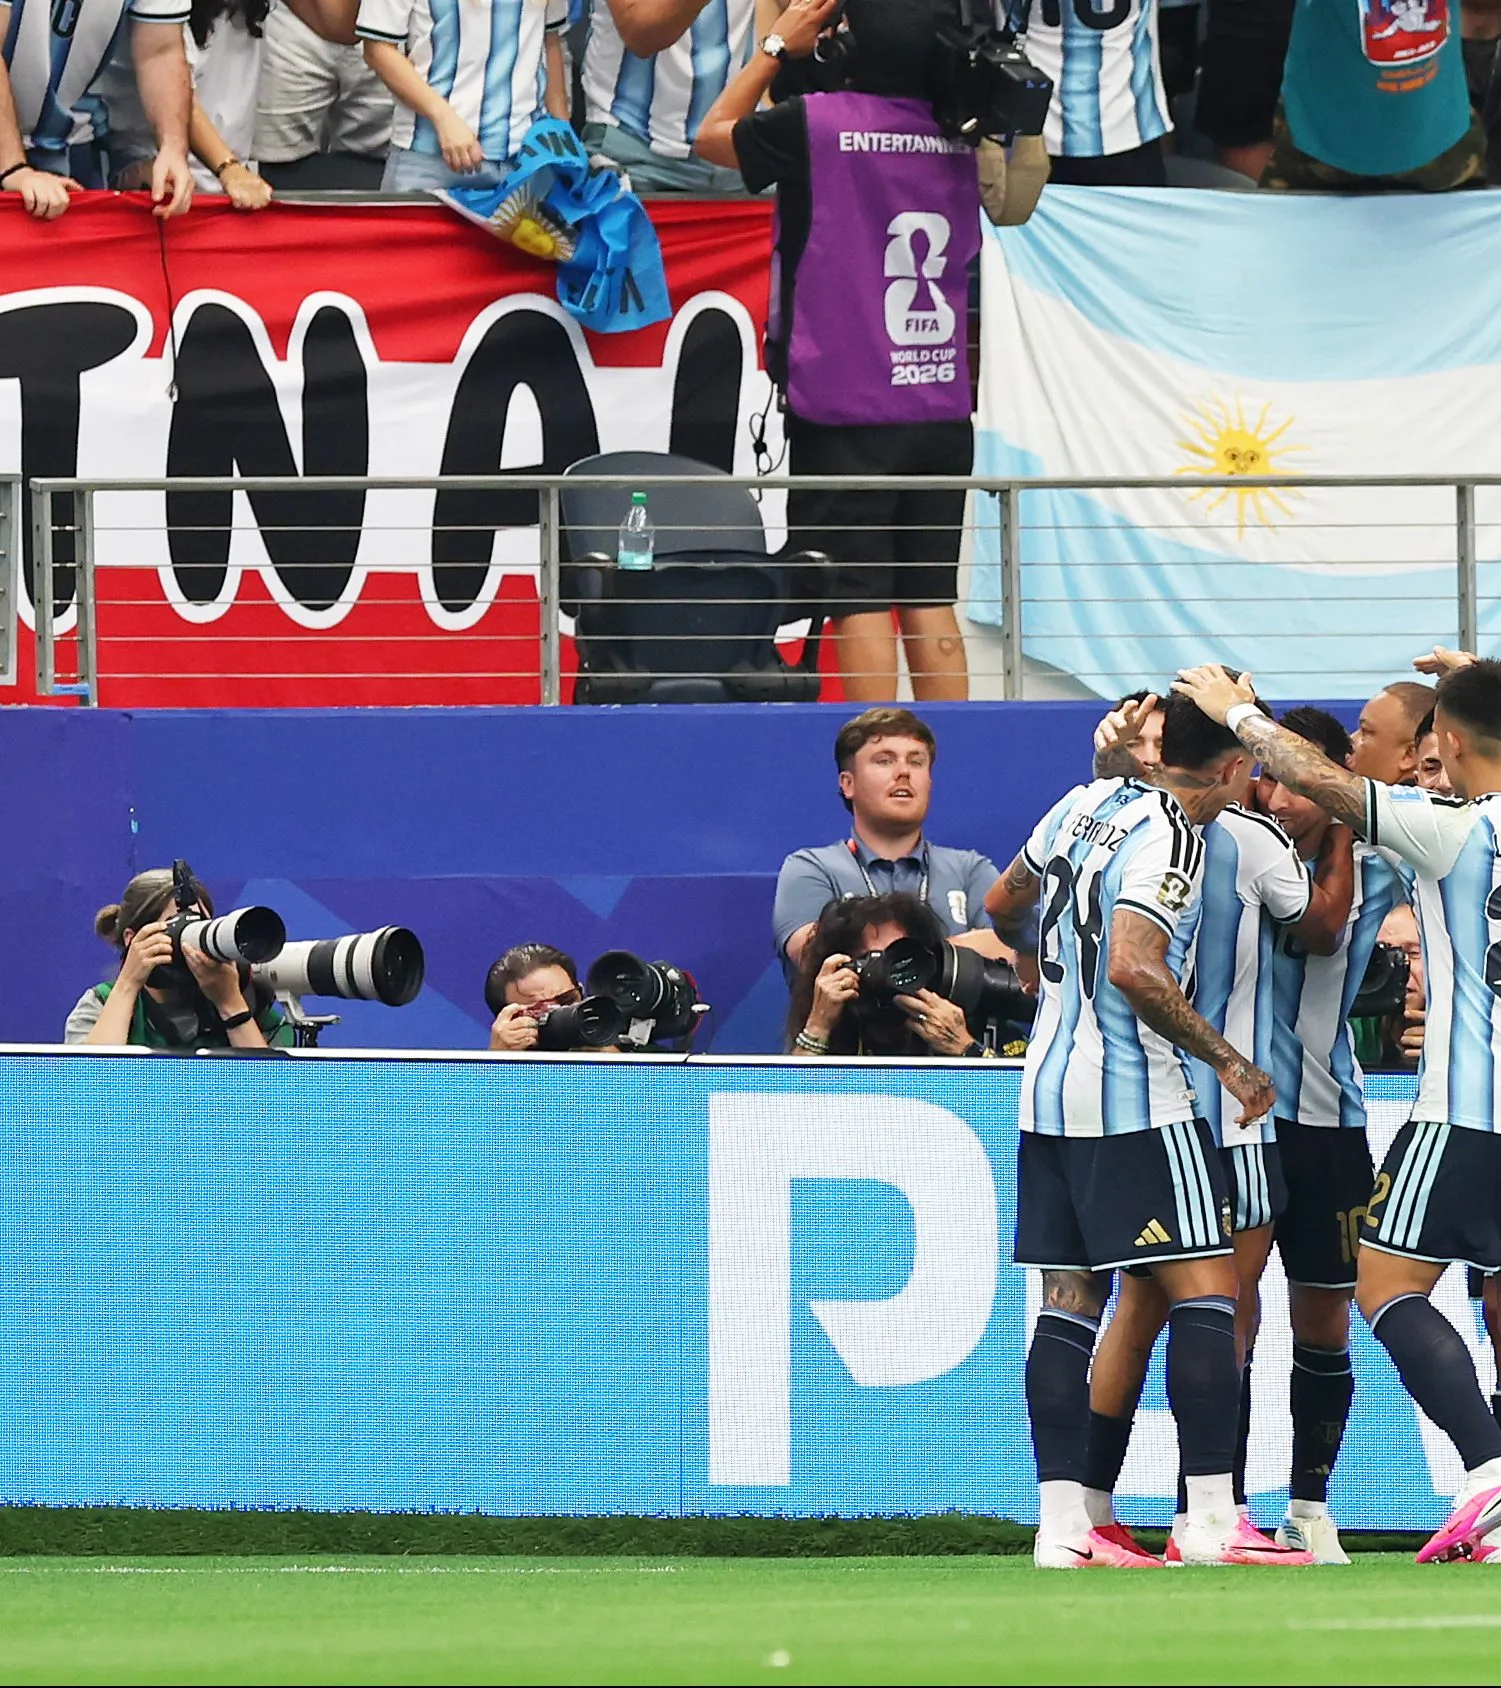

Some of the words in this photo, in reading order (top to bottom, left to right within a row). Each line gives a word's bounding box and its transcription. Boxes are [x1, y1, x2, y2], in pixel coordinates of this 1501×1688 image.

[905, 318, 940, 332] FIFA
[890, 350, 931, 363] WORLD
[931, 348, 957, 362] CUP
[890, 362, 956, 386] 2026
[1041, 854, 1103, 1000] 24
